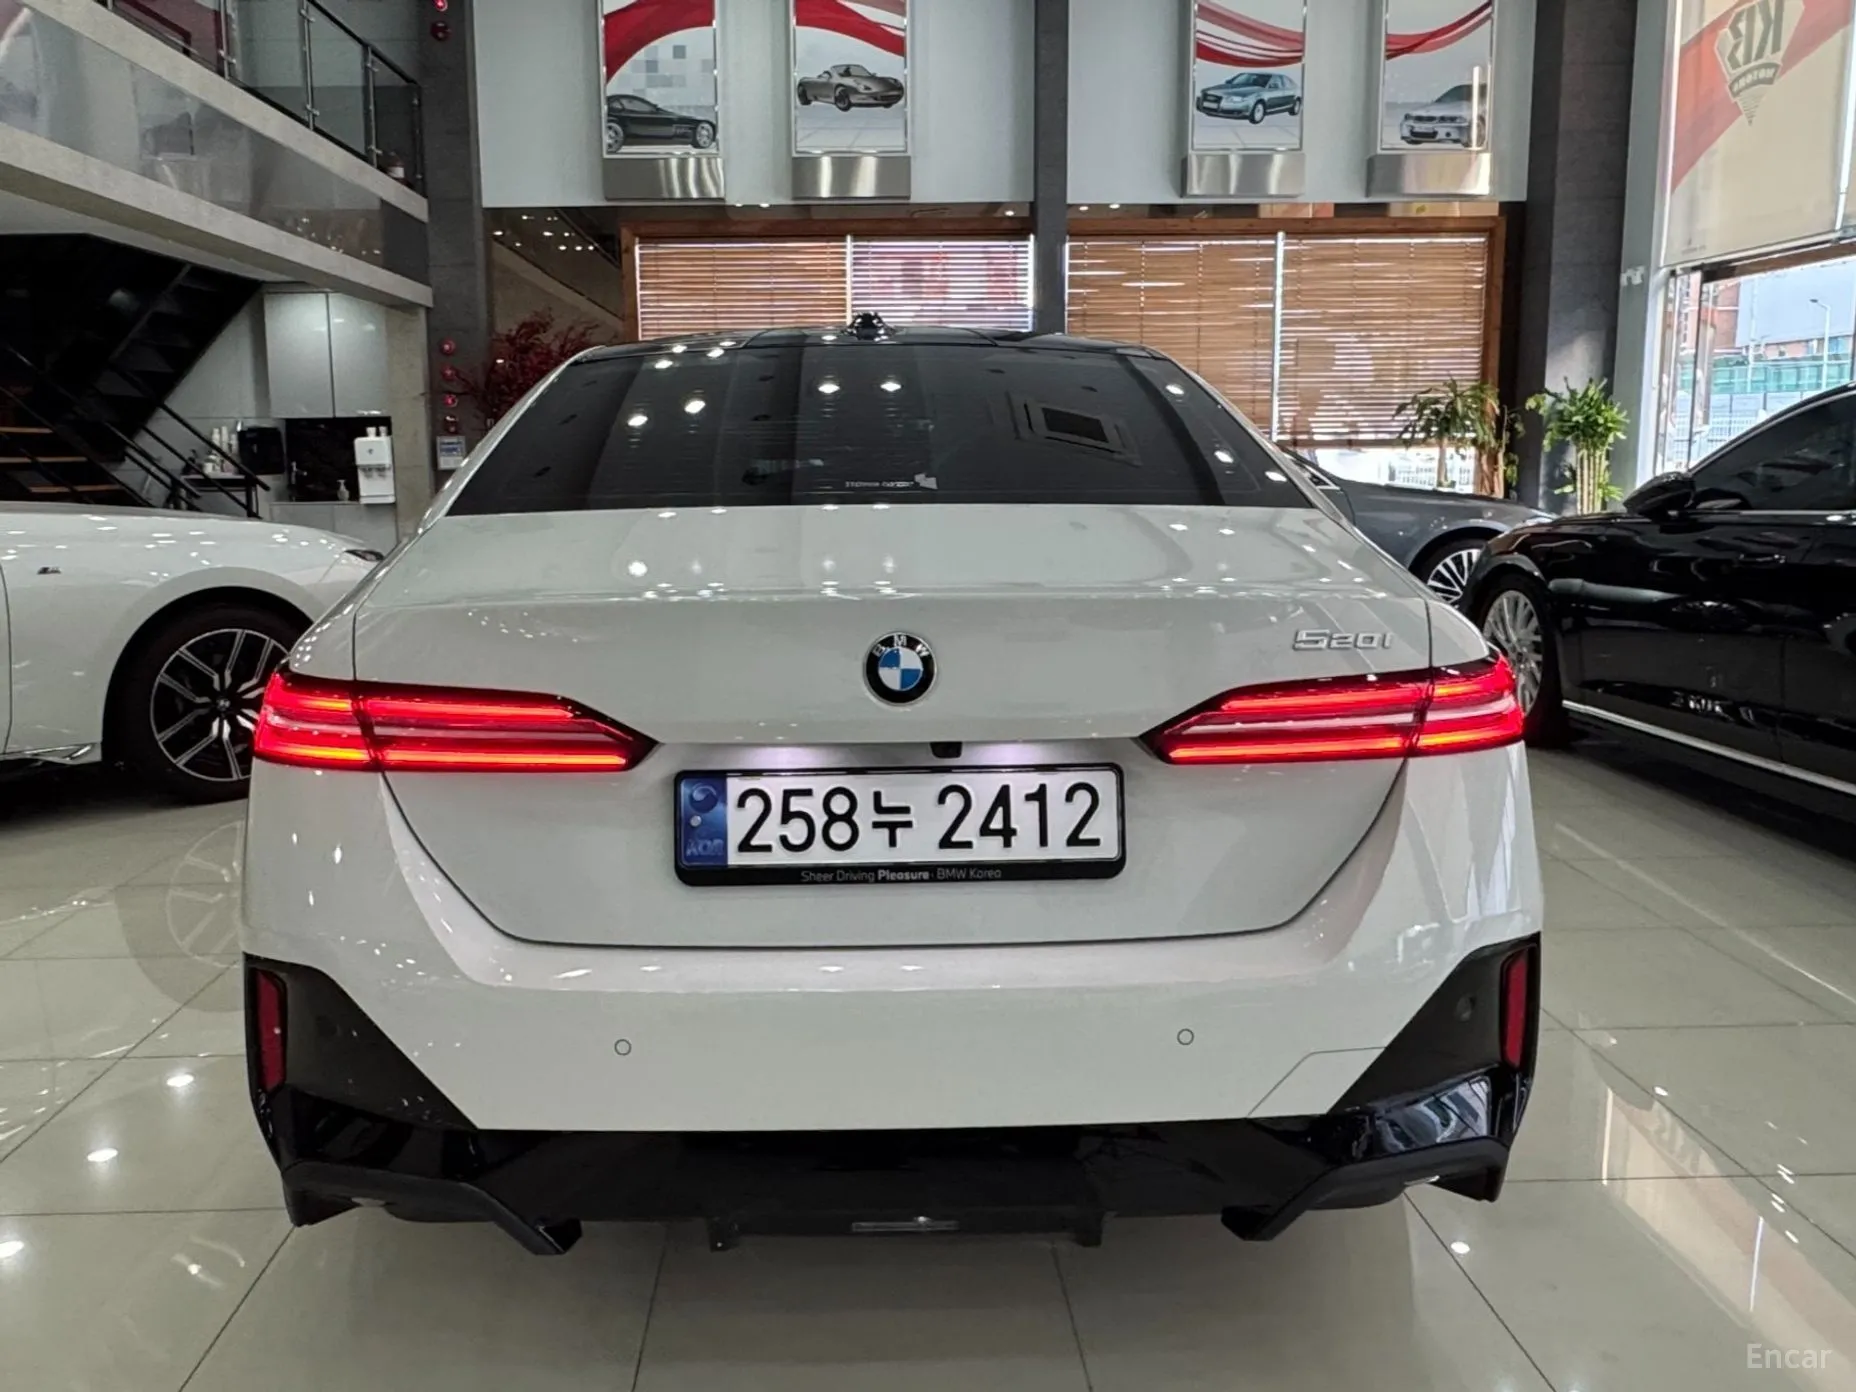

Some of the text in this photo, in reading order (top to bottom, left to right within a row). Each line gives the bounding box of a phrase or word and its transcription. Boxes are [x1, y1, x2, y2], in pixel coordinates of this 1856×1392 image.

[872, 634, 930, 657] BMW
[736, 782, 1101, 852] 258누 2412
[800, 867, 1002, 883] Sheer Driving Pleasure BMW Korea
